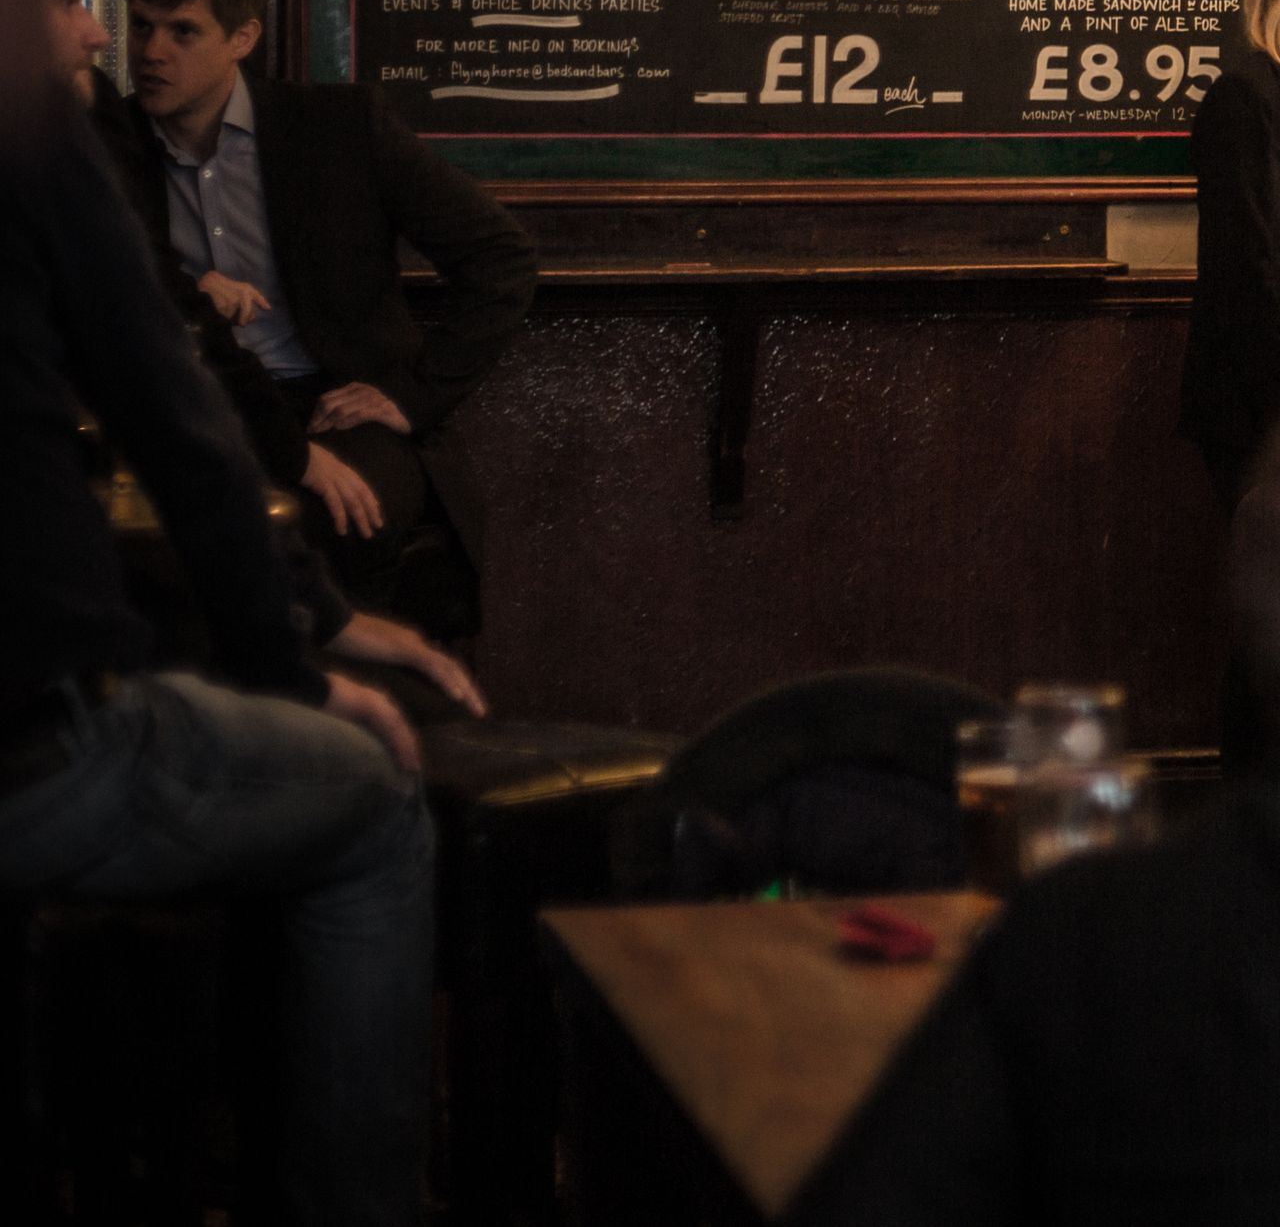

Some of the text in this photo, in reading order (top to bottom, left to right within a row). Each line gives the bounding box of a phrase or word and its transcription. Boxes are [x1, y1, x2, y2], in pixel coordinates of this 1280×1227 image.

[1020, 15, 1222, 34] AND A PINT OF ALE FOR
[416, 37, 640, 59] FOR MORE INFO ON BOOKINGS
[381, 66, 430, 81] EMAIL
[759, 34, 926, 104] £12 each
[1029, 44, 1223, 103] £8.95
